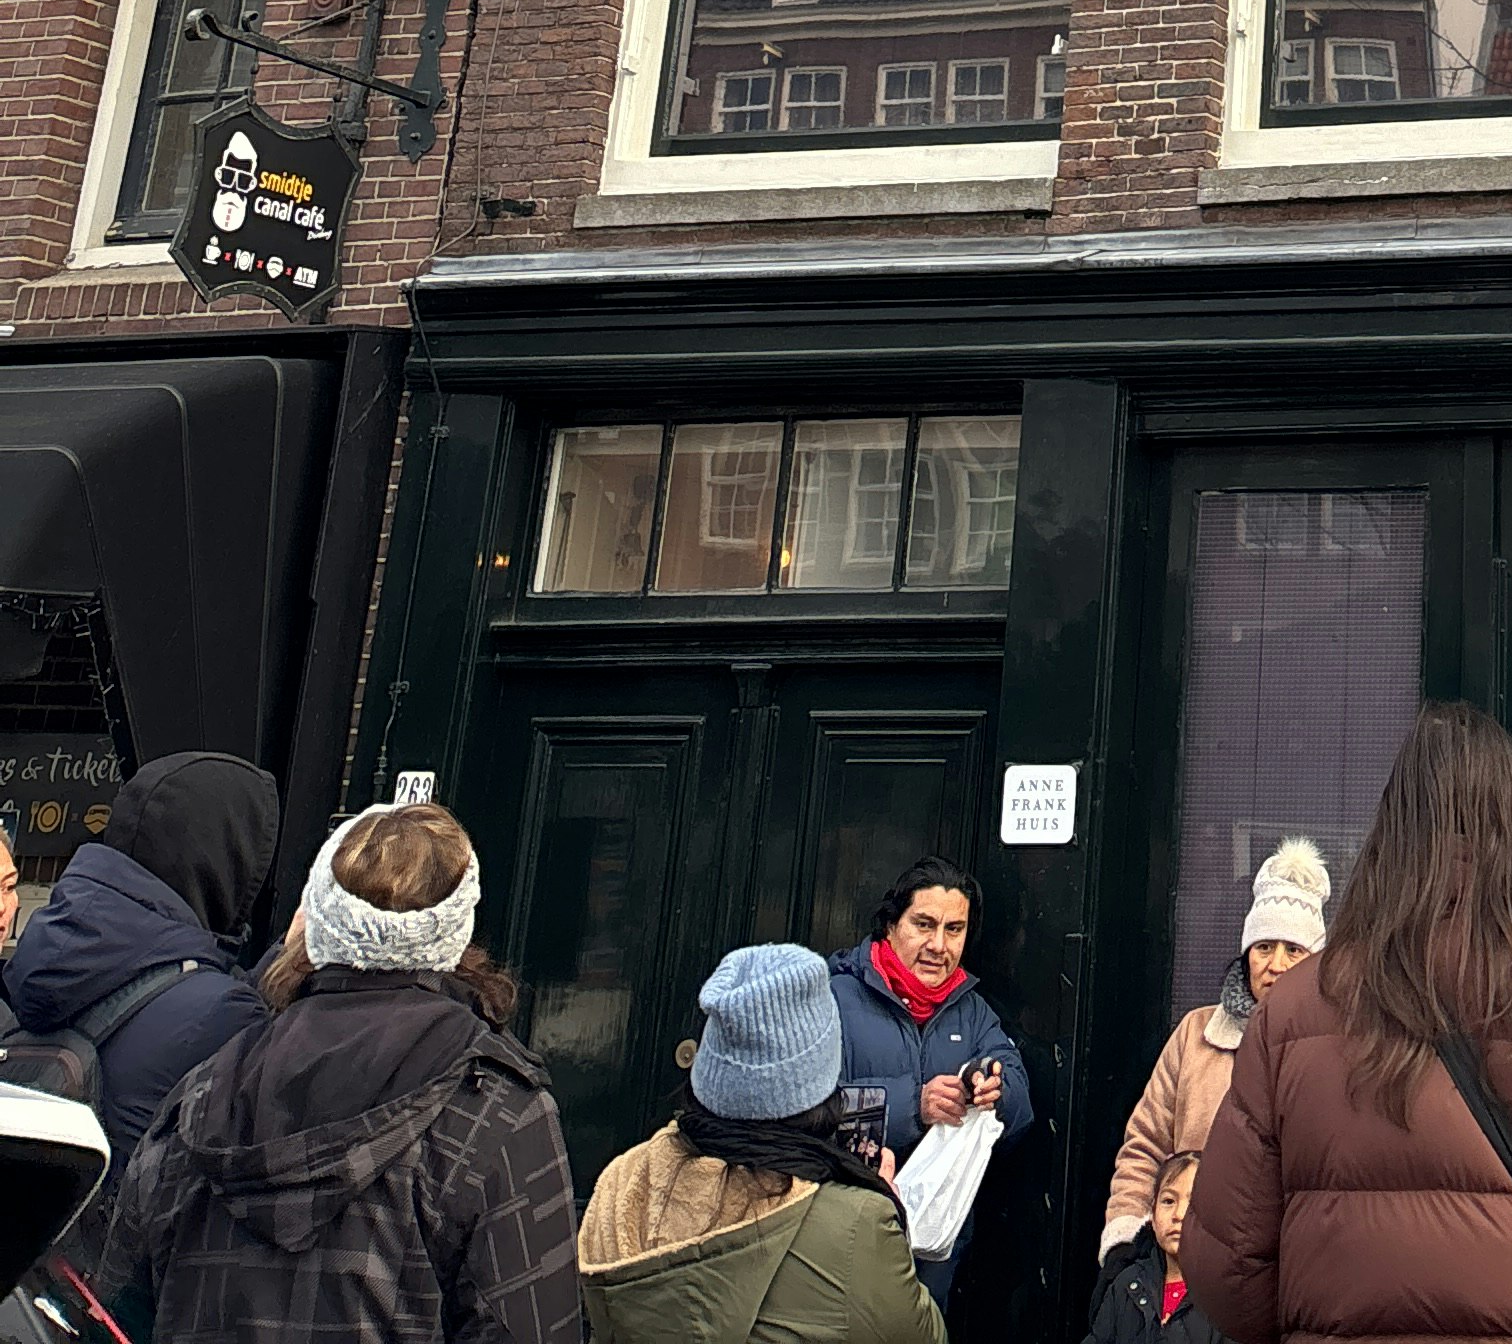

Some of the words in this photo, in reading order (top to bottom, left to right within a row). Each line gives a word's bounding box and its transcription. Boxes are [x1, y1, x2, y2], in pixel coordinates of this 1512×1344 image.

[259, 170, 313, 204] smidtje
[254, 195, 294, 222] canal
[294, 204, 326, 230] café
[294, 265, 319, 285] ATM
[21, 756, 44, 780] &
[395, 775, 432, 805] 263
[1016, 778, 1064, 792] ANNE
[1010, 797, 1067, 812] FRANK
[1015, 817, 1060, 831] HUIS
